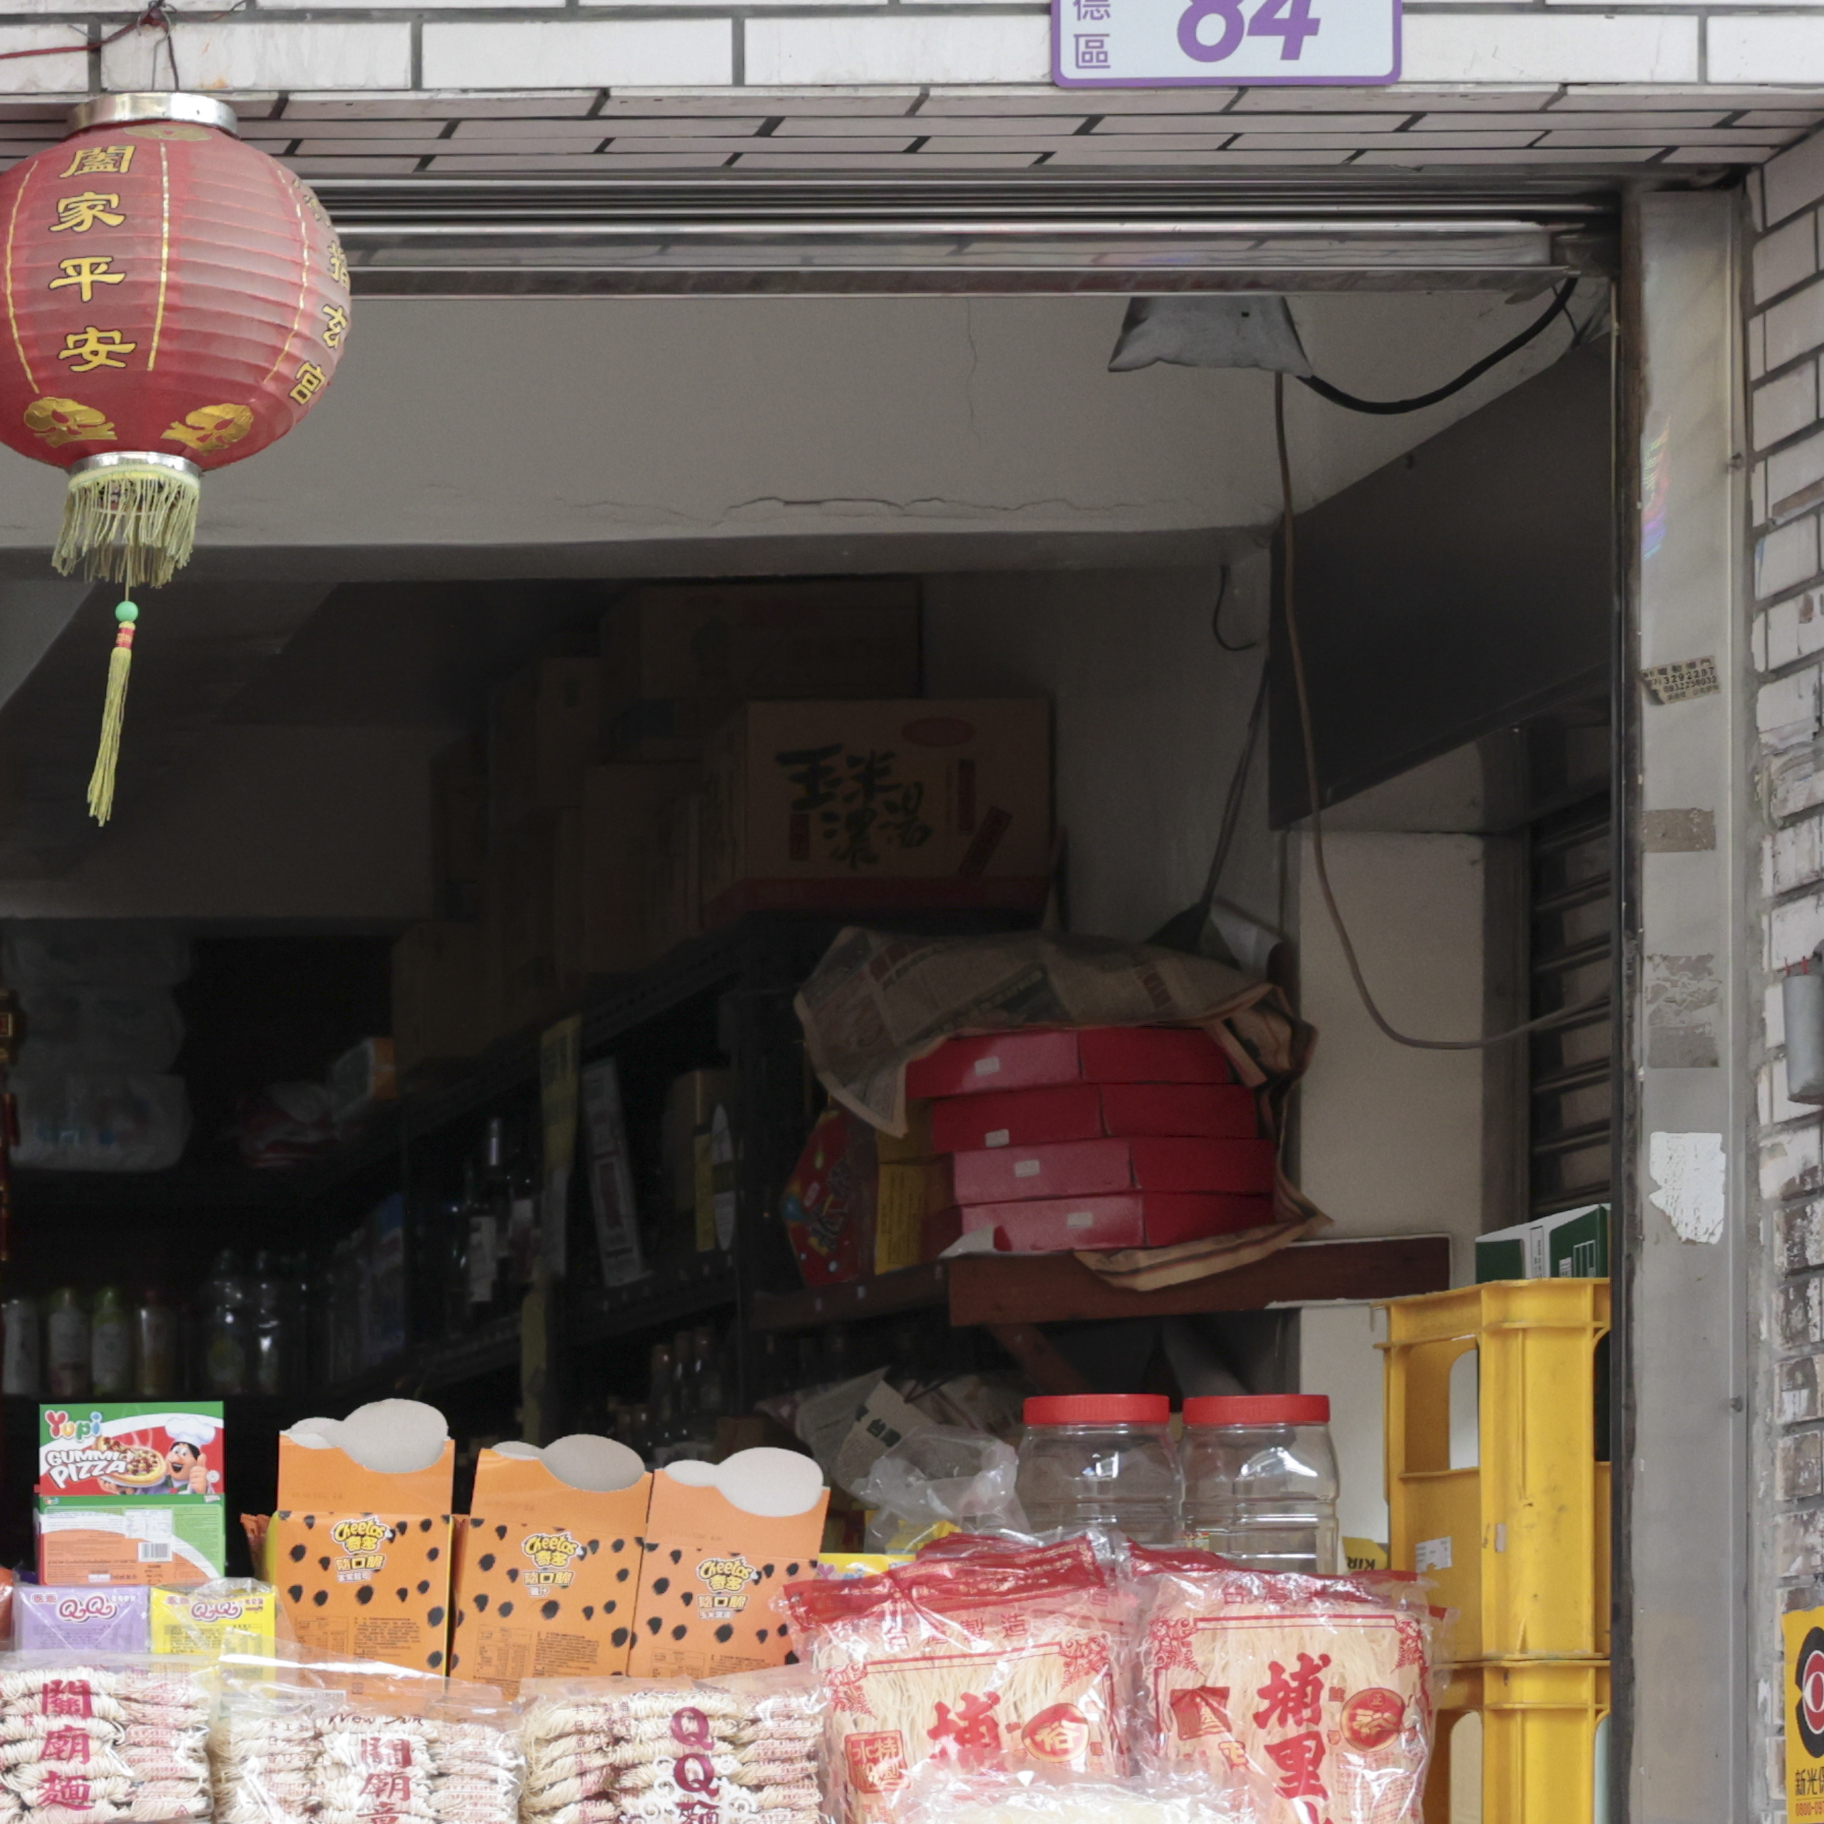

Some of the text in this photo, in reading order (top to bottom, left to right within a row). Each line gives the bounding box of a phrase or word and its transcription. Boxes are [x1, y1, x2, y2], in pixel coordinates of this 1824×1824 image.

[1176, 0, 1322, 63] 84
[47, 144, 139, 374] 闔家平安
[44, 1410, 104, 1441] Yupi
[48, 1459, 129, 1489] PIZZA
[332, 1516, 389, 1542] Cheetos
[523, 1531, 581, 1556] Cheetos
[699, 1556, 757, 1582] Cheetos
[38, 1678, 95, 1812] 關廟麵
